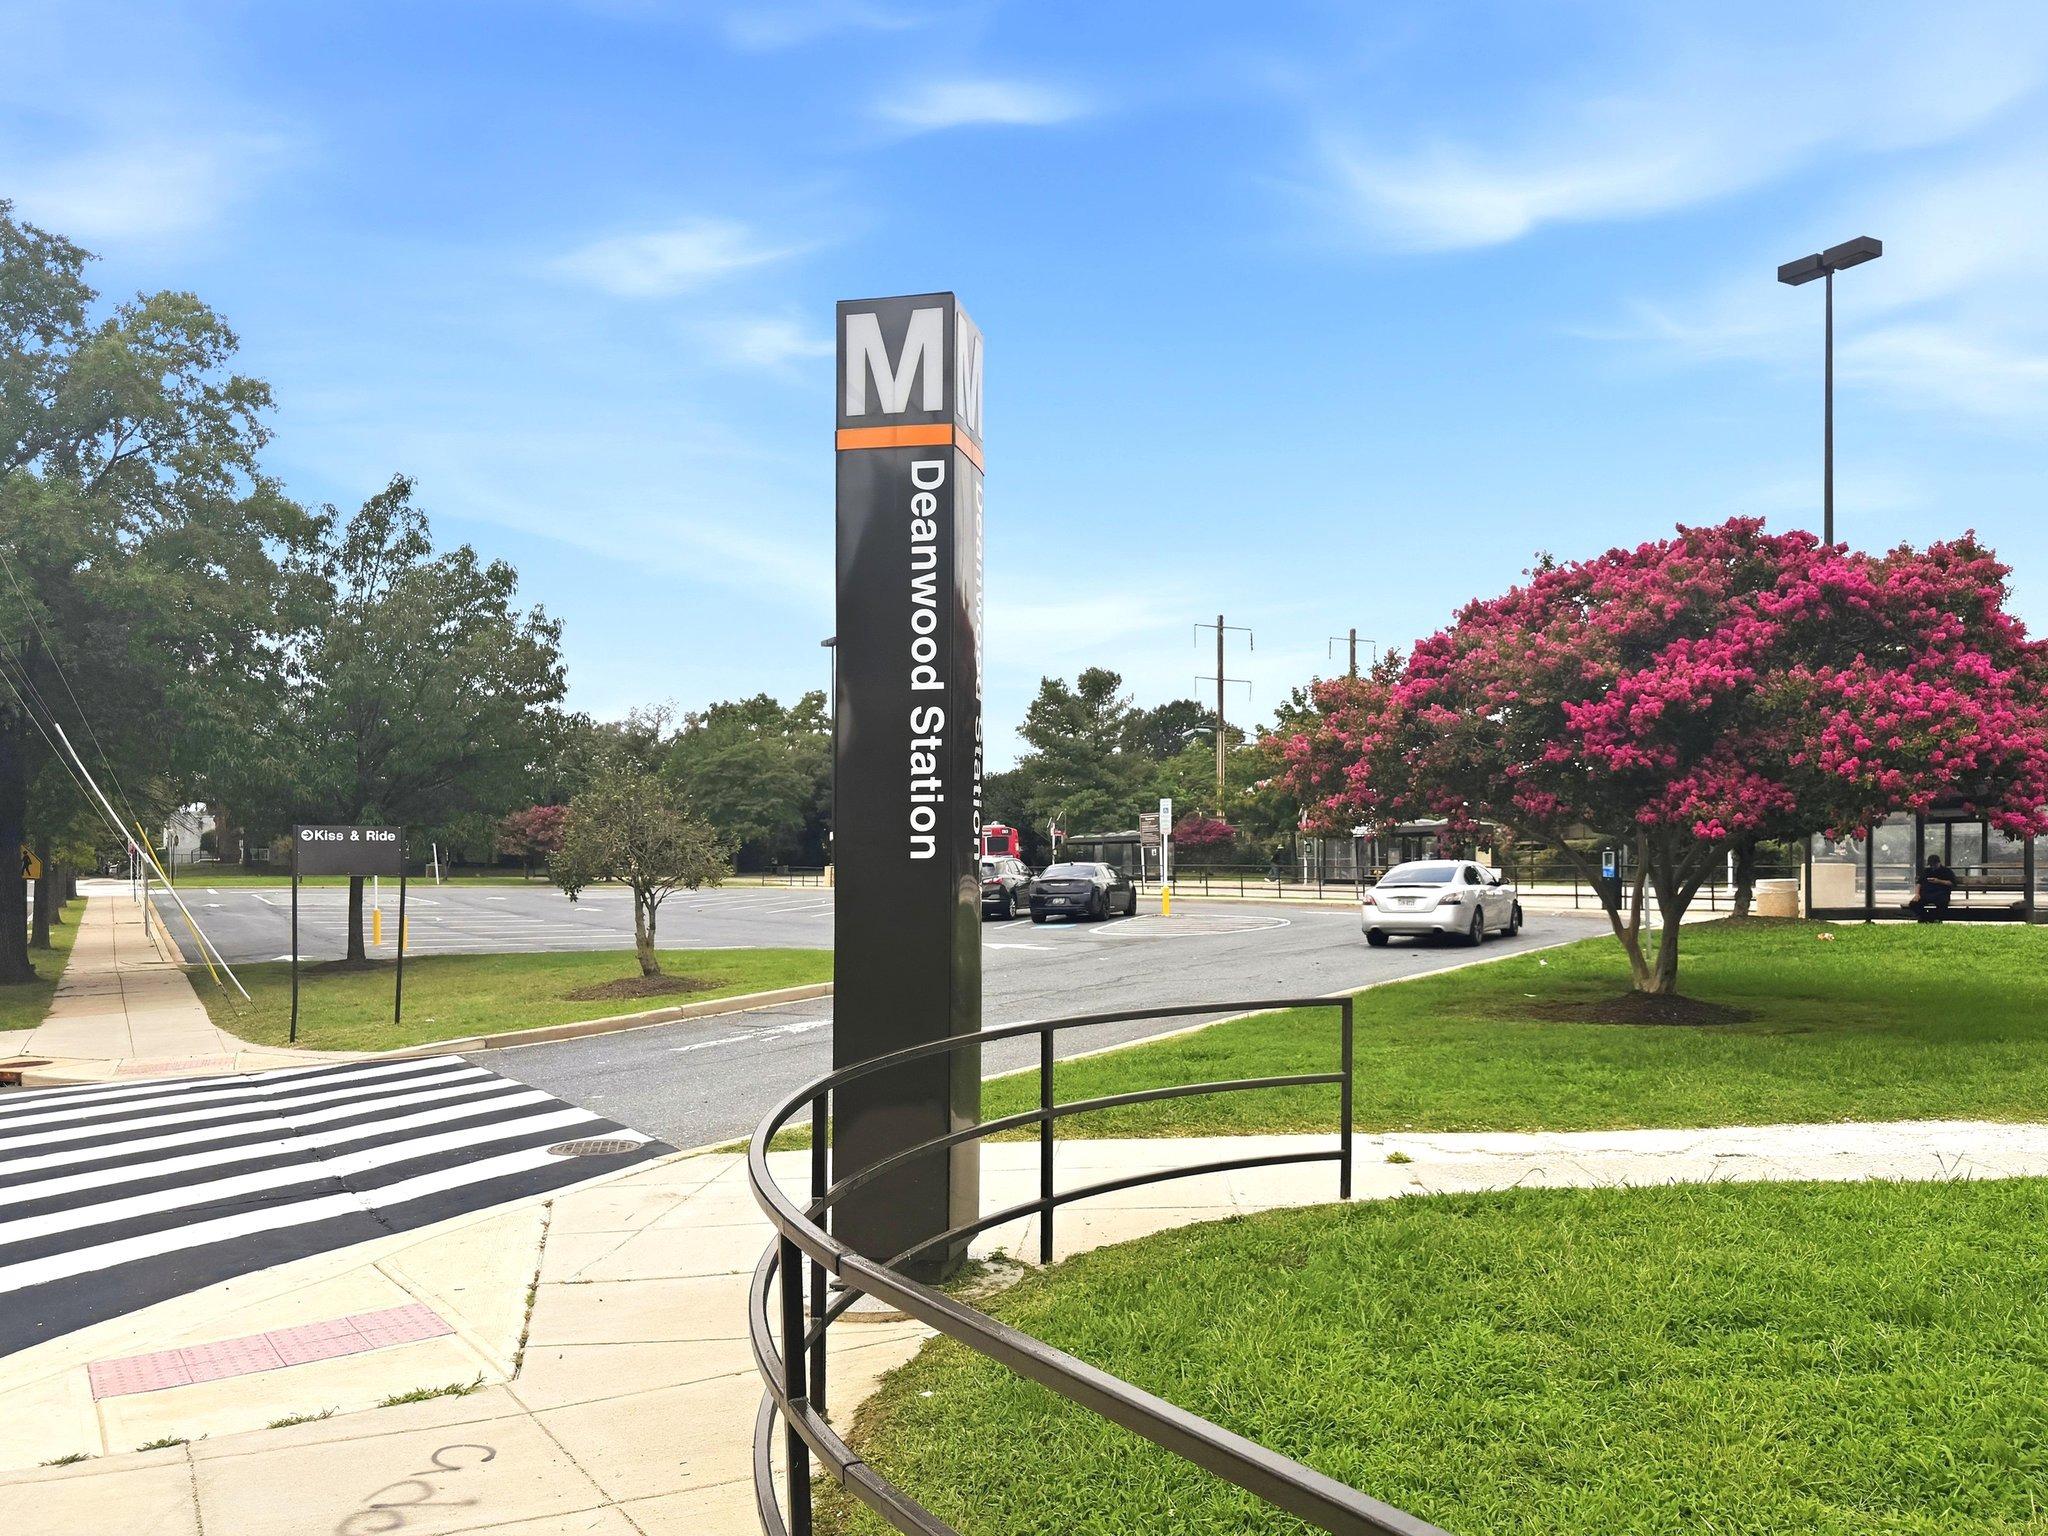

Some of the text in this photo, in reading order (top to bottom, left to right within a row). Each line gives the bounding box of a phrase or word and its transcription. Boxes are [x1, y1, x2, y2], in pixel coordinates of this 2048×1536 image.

[846, 307, 943, 416] M
[957, 312, 983, 442] M
[910, 459, 945, 860] Deanwood Station
[314, 829, 396, 841] Kiss & Ride
[974, 714, 983, 861] Station
